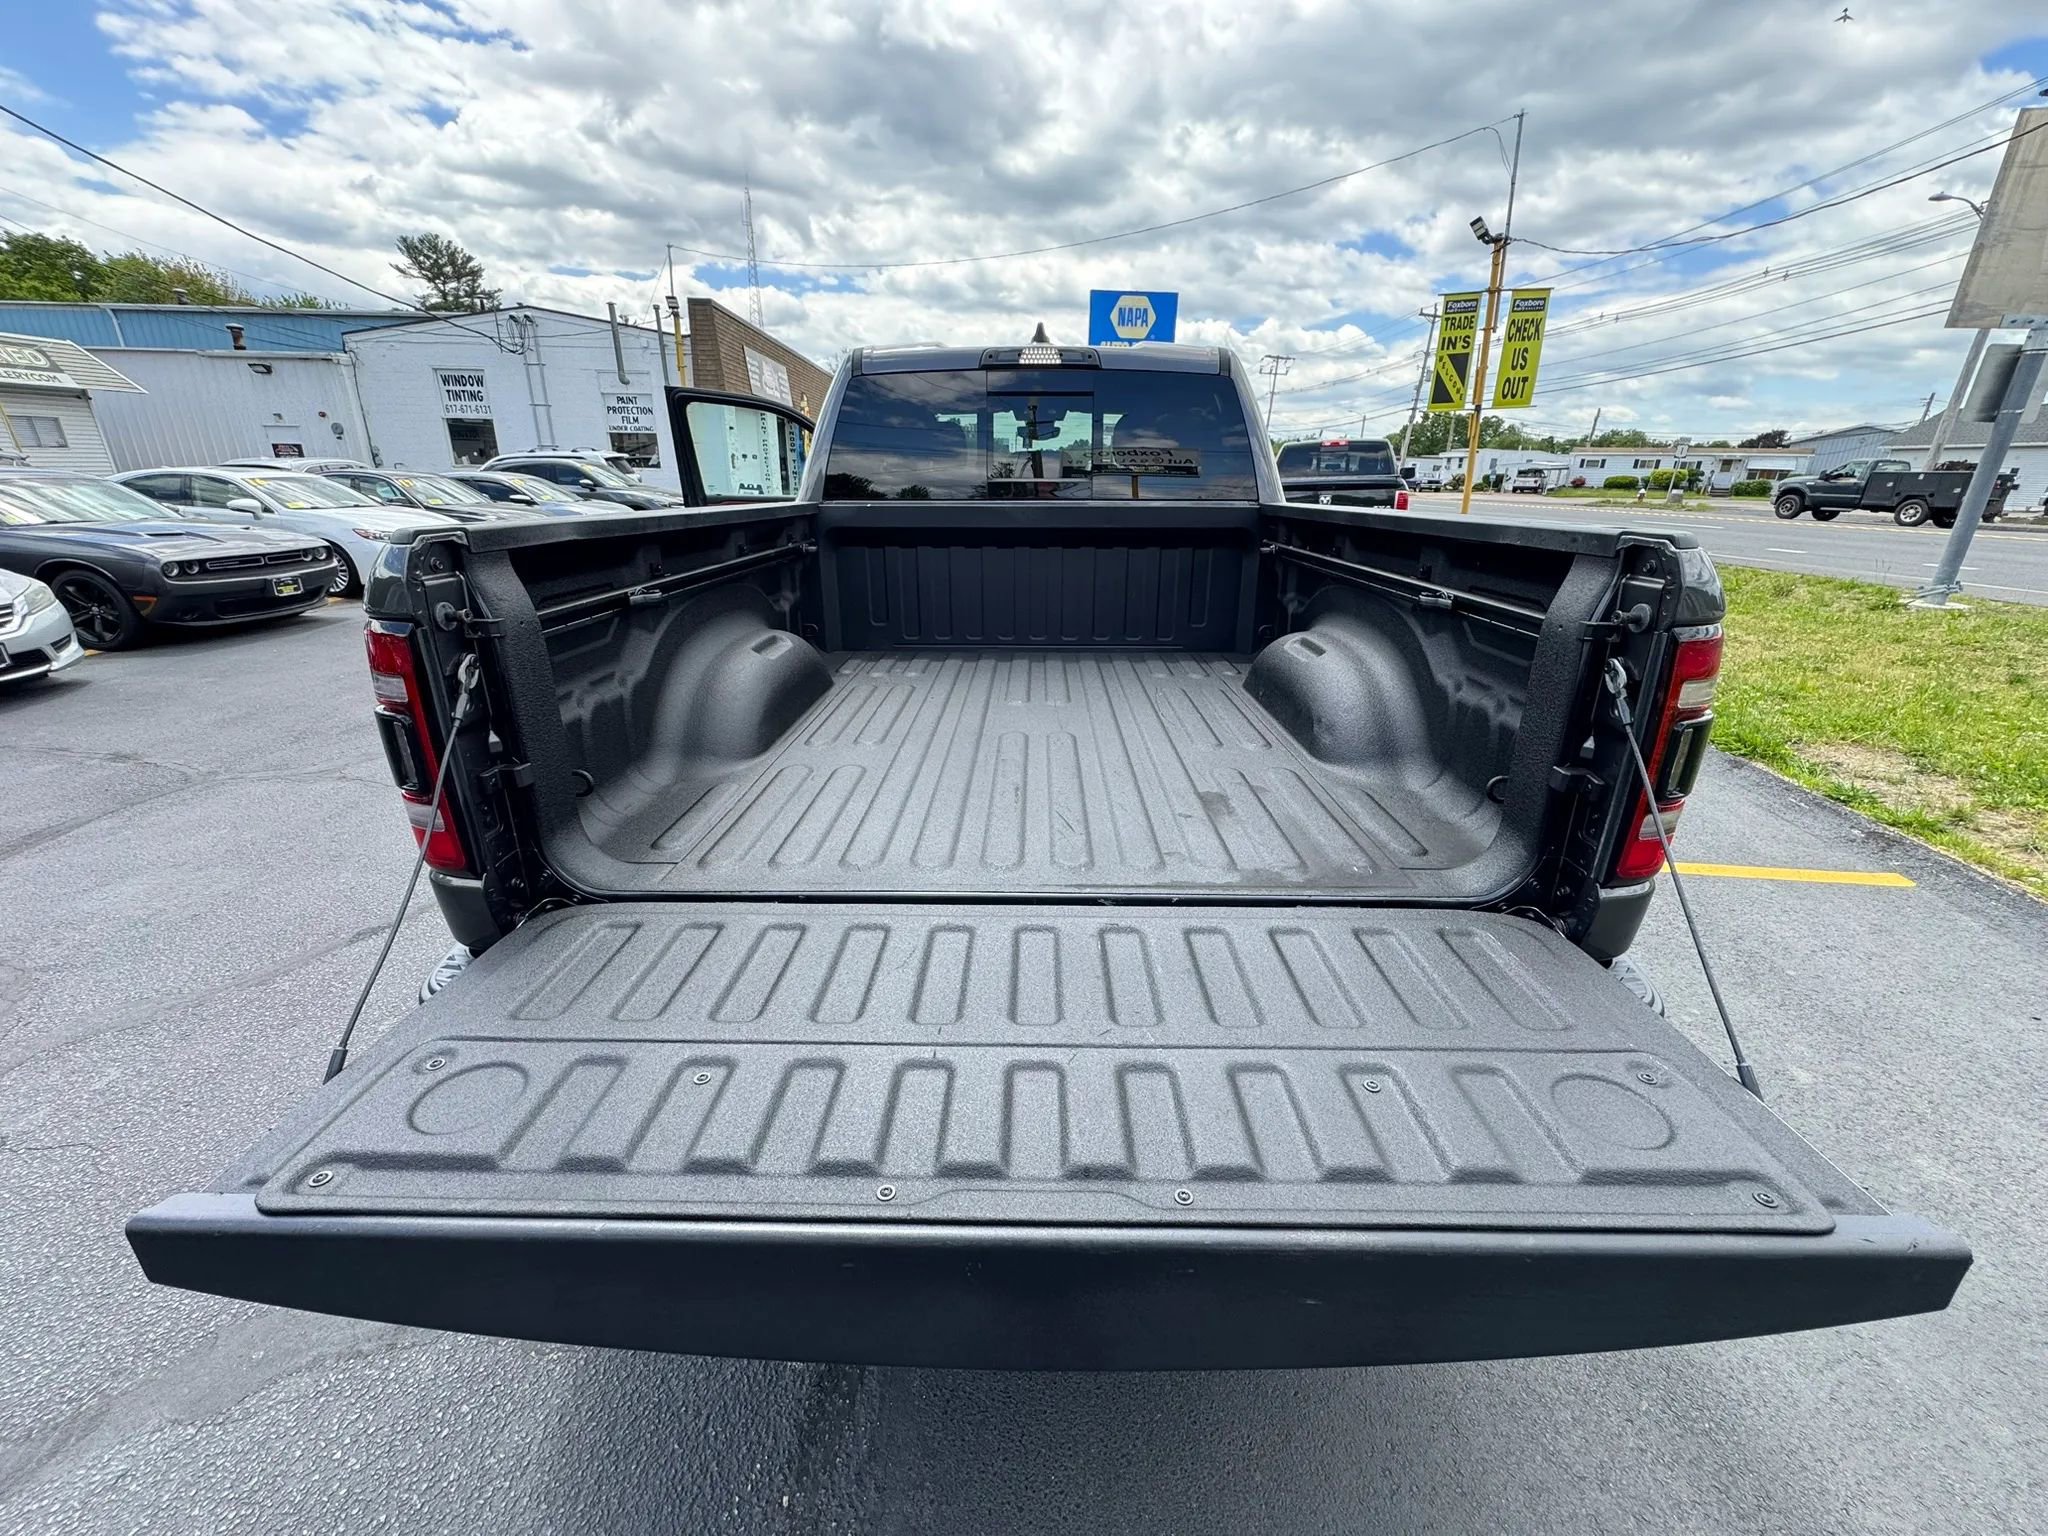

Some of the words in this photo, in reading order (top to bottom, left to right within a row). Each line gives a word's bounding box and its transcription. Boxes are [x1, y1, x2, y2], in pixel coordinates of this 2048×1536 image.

[1447, 300, 1477, 309] Foxboro
[1515, 299, 1545, 307] Foxboro
[1117, 307, 1149, 328] NAPA
[1444, 315, 1475, 331] TRADE
[1507, 317, 1543, 343] CHECK
[1441, 335, 1471, 351] IN'S
[1511, 347, 1529, 371] US
[440, 374, 484, 387] WINDOW
[1439, 355, 1464, 401] WELCOME
[1502, 376, 1529, 400] OUT
[446, 389, 484, 402] TINTING
[616, 395, 638, 405] PAINT
[445, 404, 492, 414] 617-671-6131
[606, 406, 654, 415] PROTECTION
[621, 415, 640, 425] FILM
